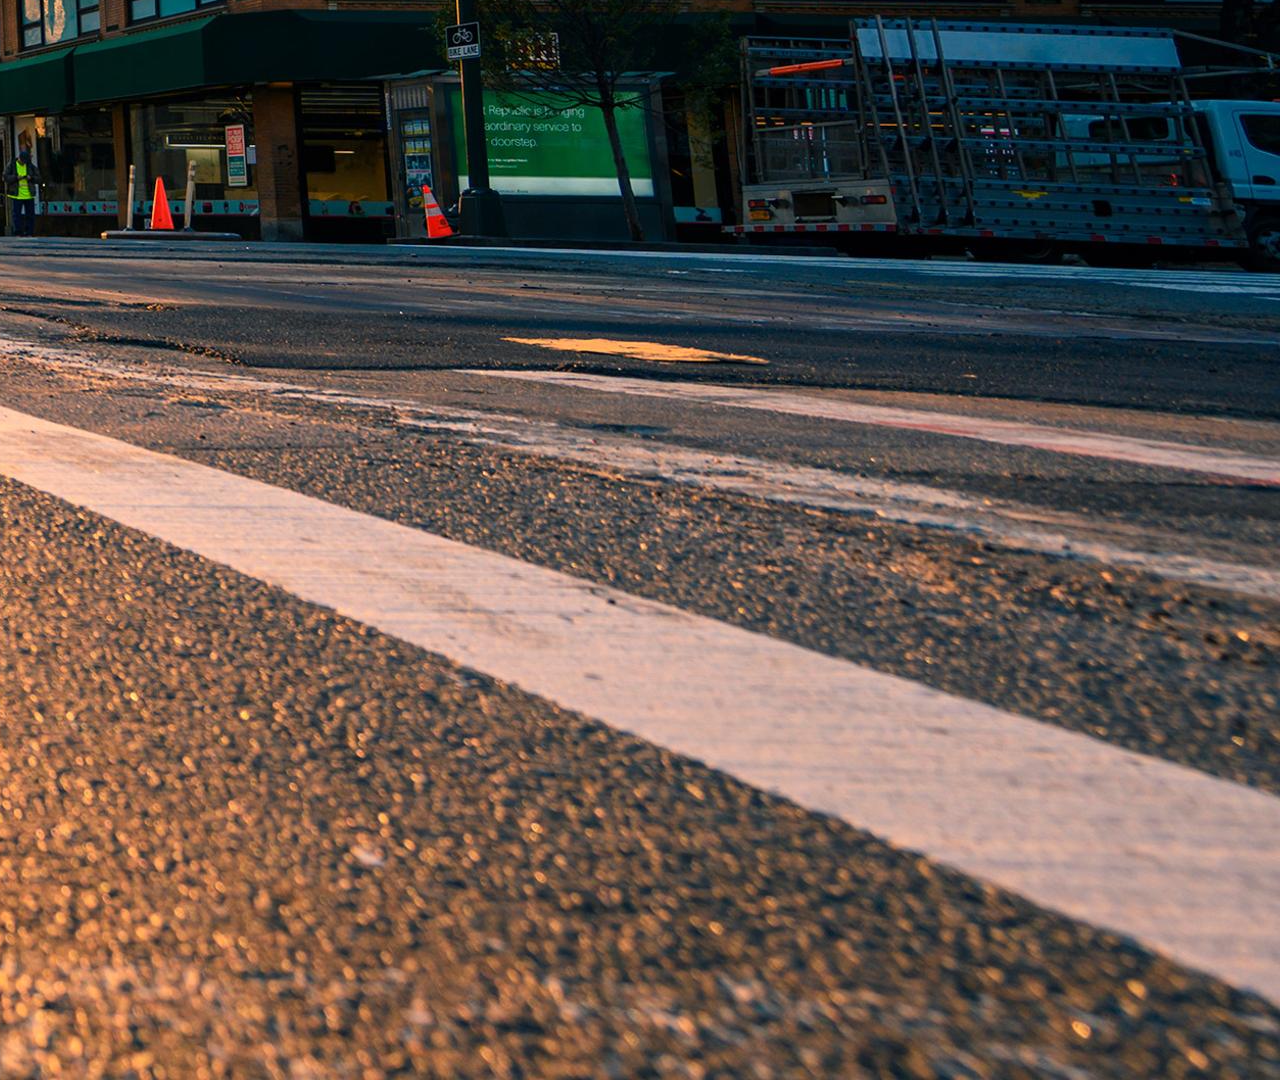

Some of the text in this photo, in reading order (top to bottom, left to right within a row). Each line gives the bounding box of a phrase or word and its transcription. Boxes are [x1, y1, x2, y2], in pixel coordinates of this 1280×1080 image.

[449, 45, 479, 57] BIKE LANE
[533, 123, 569, 132] service
[572, 123, 582, 132] to
